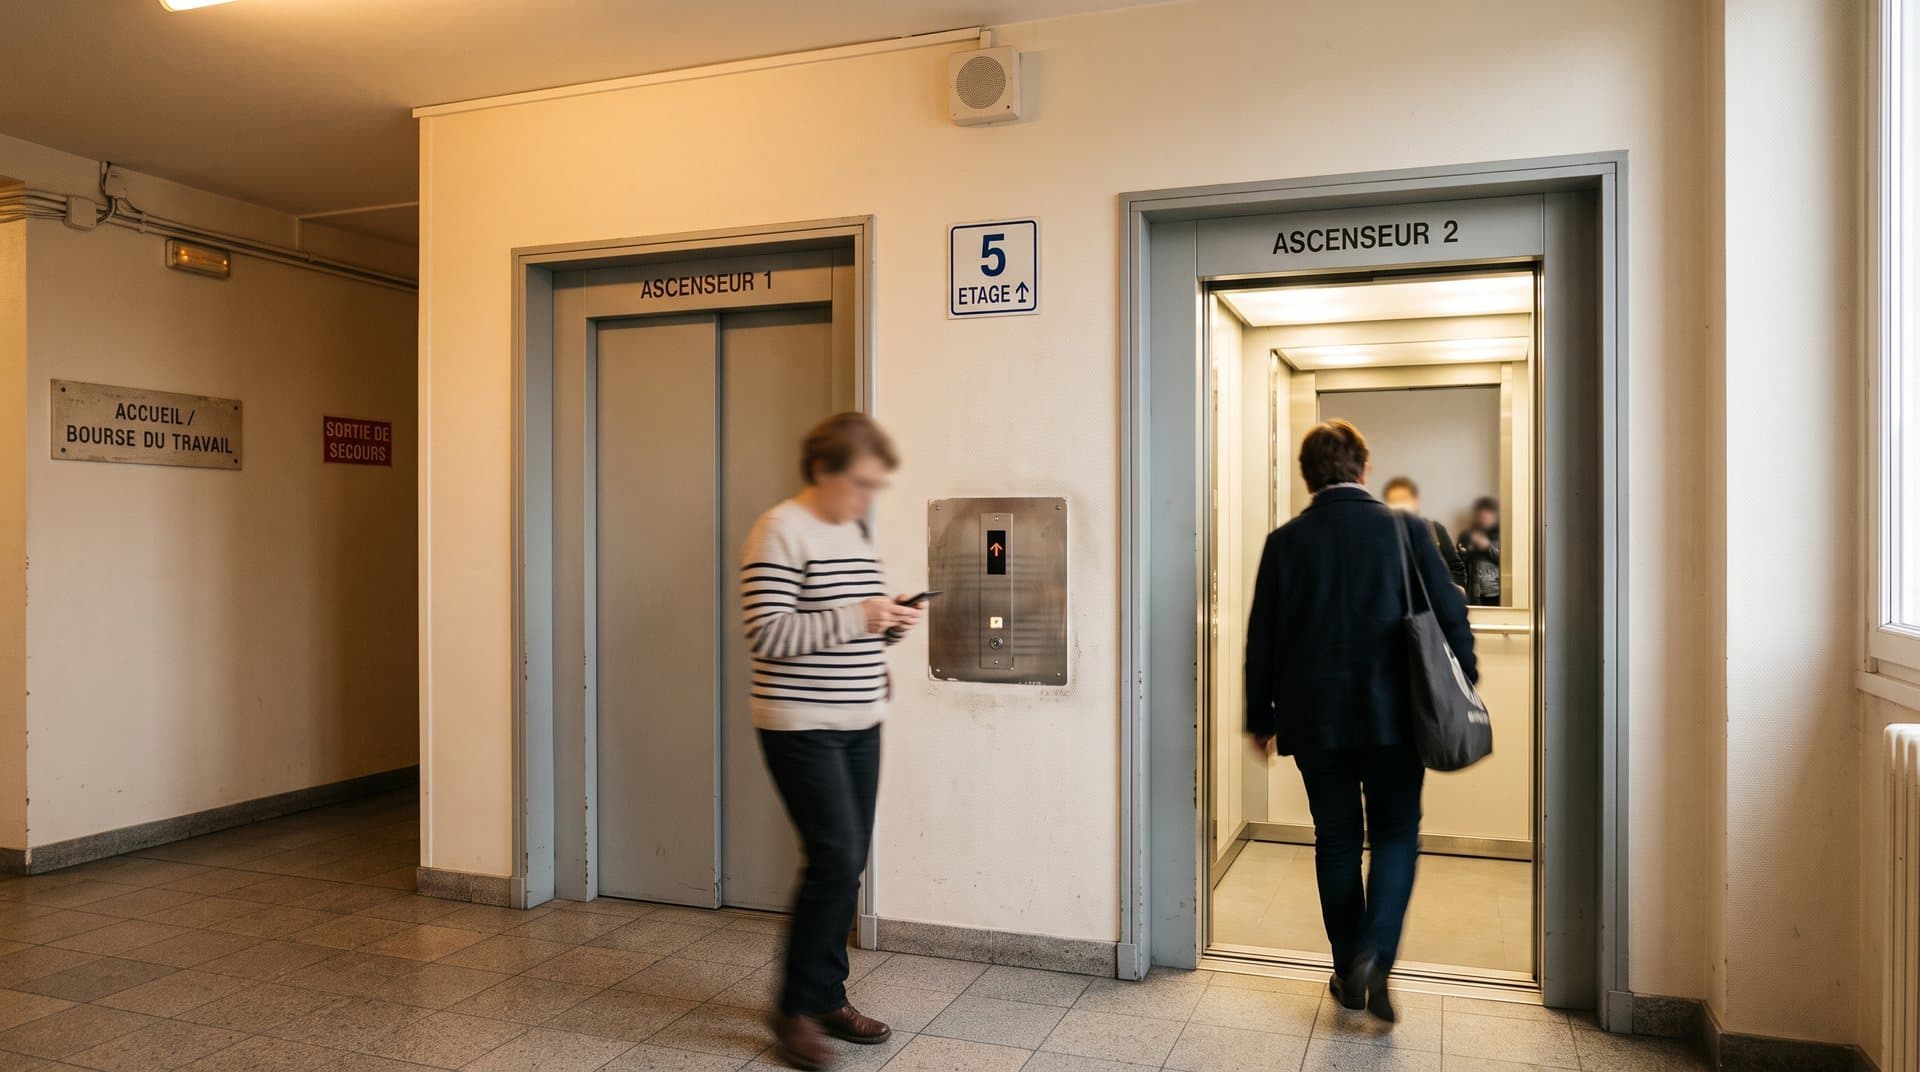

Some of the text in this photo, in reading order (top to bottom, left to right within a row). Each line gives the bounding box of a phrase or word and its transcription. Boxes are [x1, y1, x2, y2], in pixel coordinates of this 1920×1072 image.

[1272, 220, 1459, 255] ASCENSEUR 2
[980, 233, 1006, 277] 5
[640, 269, 772, 299] ASCENSEUR 1
[958, 284, 1011, 305] ETAGE
[115, 403, 183, 426] ACCUEIL
[66, 424, 233, 454] BOURSE DU TRAVAIL
[326, 421, 389, 442] SORTIE DE
[329, 442, 386, 462] SECOURS
